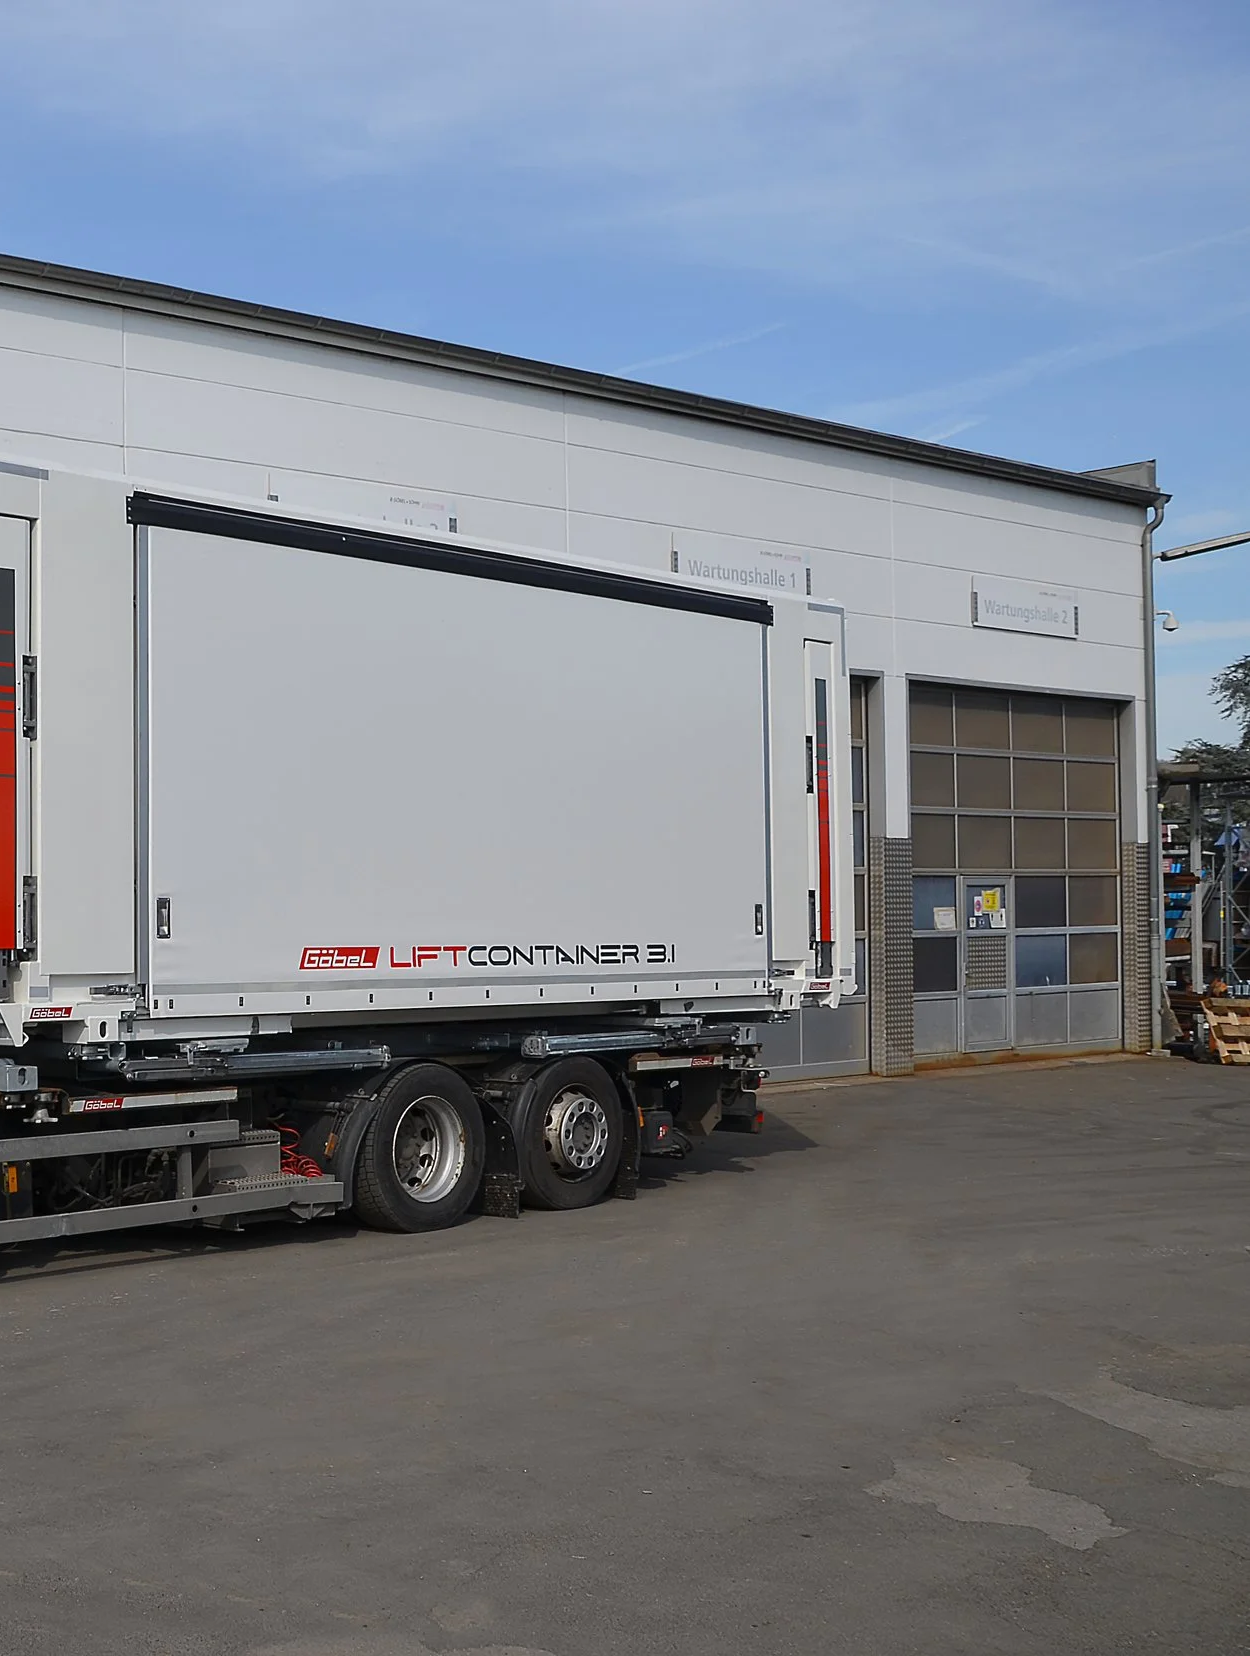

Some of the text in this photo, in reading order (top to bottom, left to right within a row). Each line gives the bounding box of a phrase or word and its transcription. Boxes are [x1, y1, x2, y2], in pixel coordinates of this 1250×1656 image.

[688, 559, 796, 589] Wartungshalle 1
[983, 599, 1068, 624] Wartungshalle 2
[389, 944, 640, 968] LIFTCONTAINER
